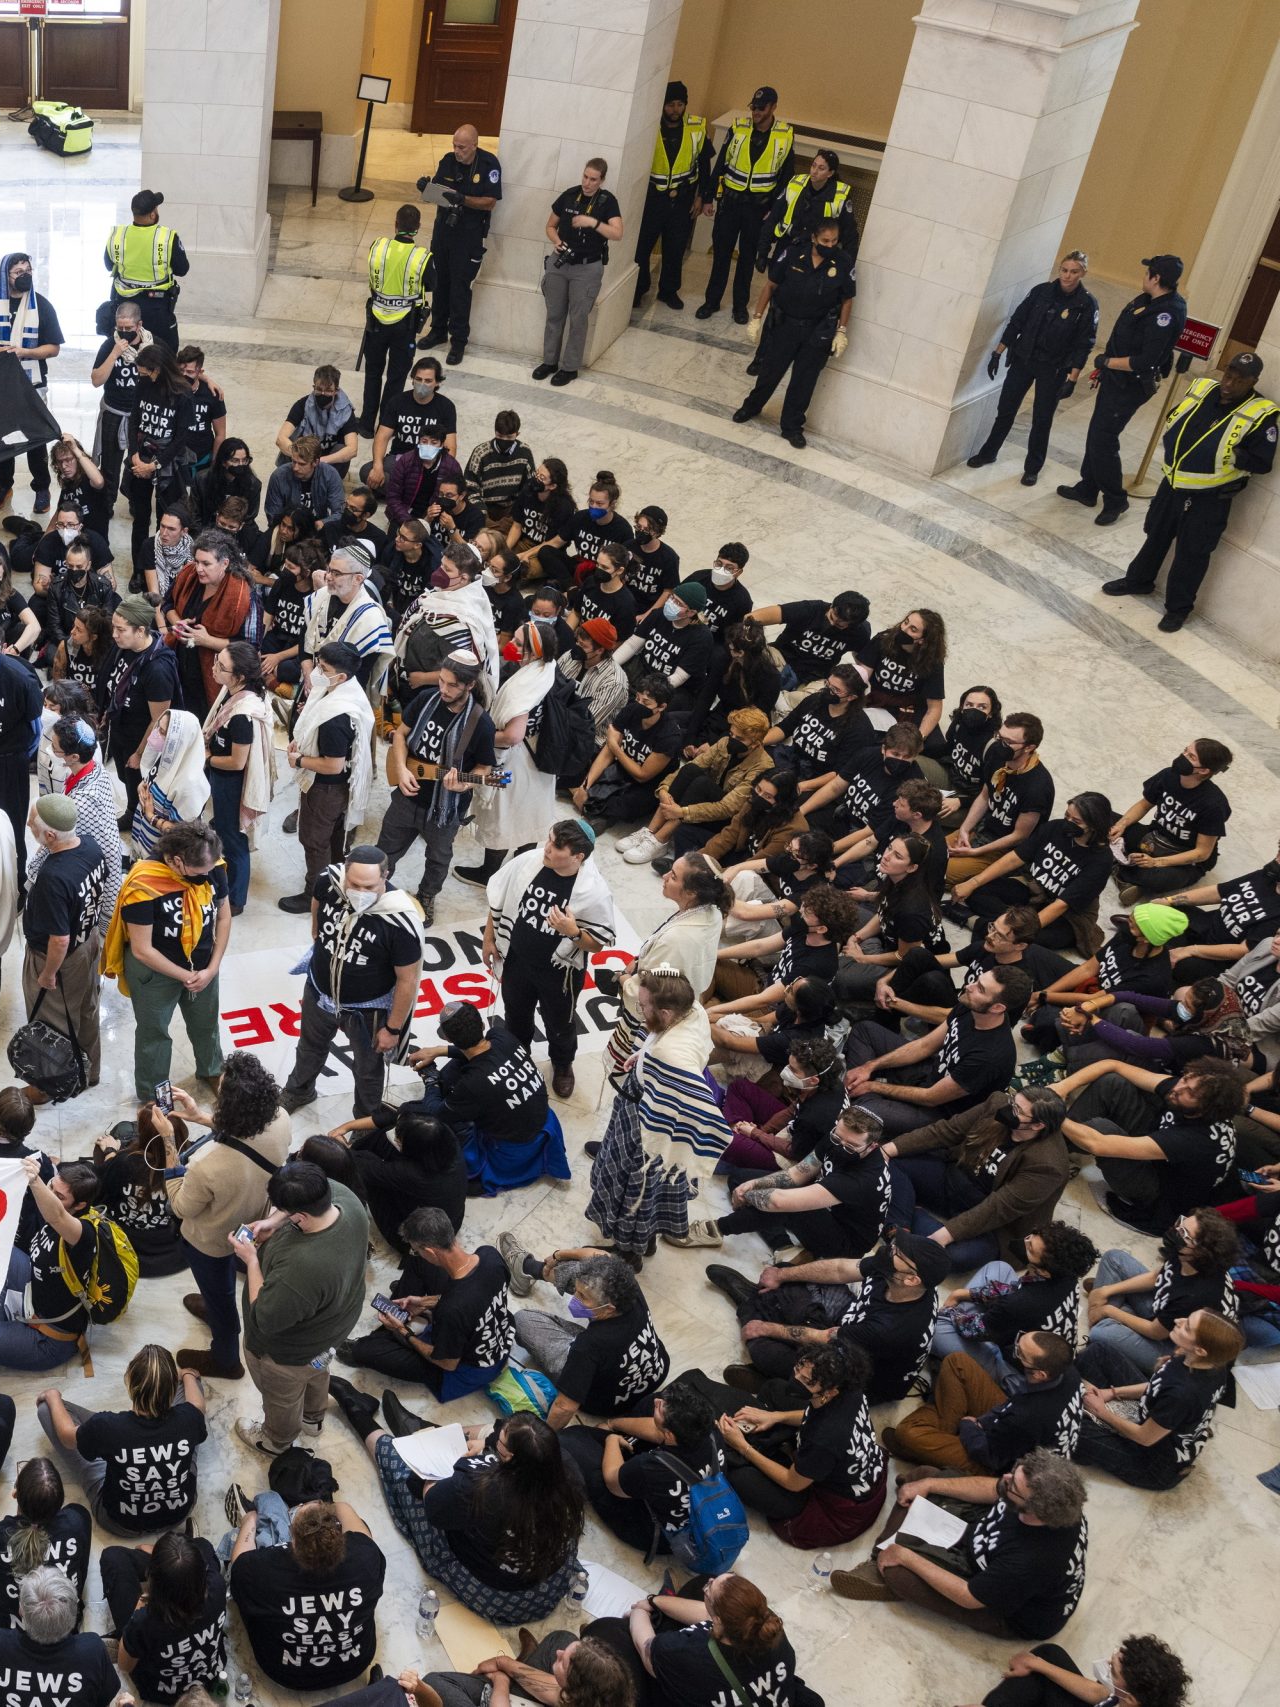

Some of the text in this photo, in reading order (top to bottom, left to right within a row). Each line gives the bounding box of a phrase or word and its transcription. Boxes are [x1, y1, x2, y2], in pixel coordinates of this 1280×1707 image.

[1192, 339, 1209, 348] ONLY
[139, 400, 159, 413] NOT
[141, 413, 168, 426] OUR
[398, 415, 421, 425] NOT
[579, 529, 602, 542] NOT
[278, 599, 299, 613] NOT
[279, 610, 305, 625] OUR
[600, 606, 612, 618] IN
[644, 640, 671, 664] OUR
[649, 628, 680, 655] NOT IN
[800, 638, 834, 659] OUR
[803, 630, 846, 651] NOT IN
[70, 662, 92, 674] NOT
[881, 657, 903, 675] NOT
[879, 670, 914, 691] OUR
[622, 729, 640, 746] NOT
[800, 721, 825, 745] OUR
[803, 713, 836, 741] NOT IN
[951, 750, 972, 773] OUR
[847, 784, 870, 813] OUR
[853, 773, 880, 806] NOT IN
[1161, 806, 1186, 827] OUR
[1181, 808, 1196, 820] IN
[1042, 857, 1070, 884] OUR
[1044, 843, 1081, 876] NOT IN
[527, 883, 557, 908] NOT
[1239, 881, 1267, 921] NOT IN
[1229, 894, 1251, 923] OUR
[357, 926, 377, 944] IN
[1104, 946, 1118, 970] NOT
[1237, 983, 1259, 1011] OUR
[487, 1045, 528, 1086] NOT IN
[505, 1059, 535, 1091] OUR
[475, 1282, 509, 1331] JEWS
[1041, 1281, 1082, 1331] JEWS
[114, 1439, 190, 1466] JEWS
[119, 1470, 188, 1492] CEASE
[126, 1461, 182, 1482] SAY
[119, 1493, 189, 1516] NOW
[130, 1487, 182, 1503] FIRE
[282, 1587, 363, 1616] JEWS
[293, 1610, 355, 1634] SAY
[160, 1610, 226, 1658] JEWS
[281, 1622, 364, 1646] CEASE
[282, 1642, 361, 1667] NOW
[296, 1639, 352, 1657] FIRE
